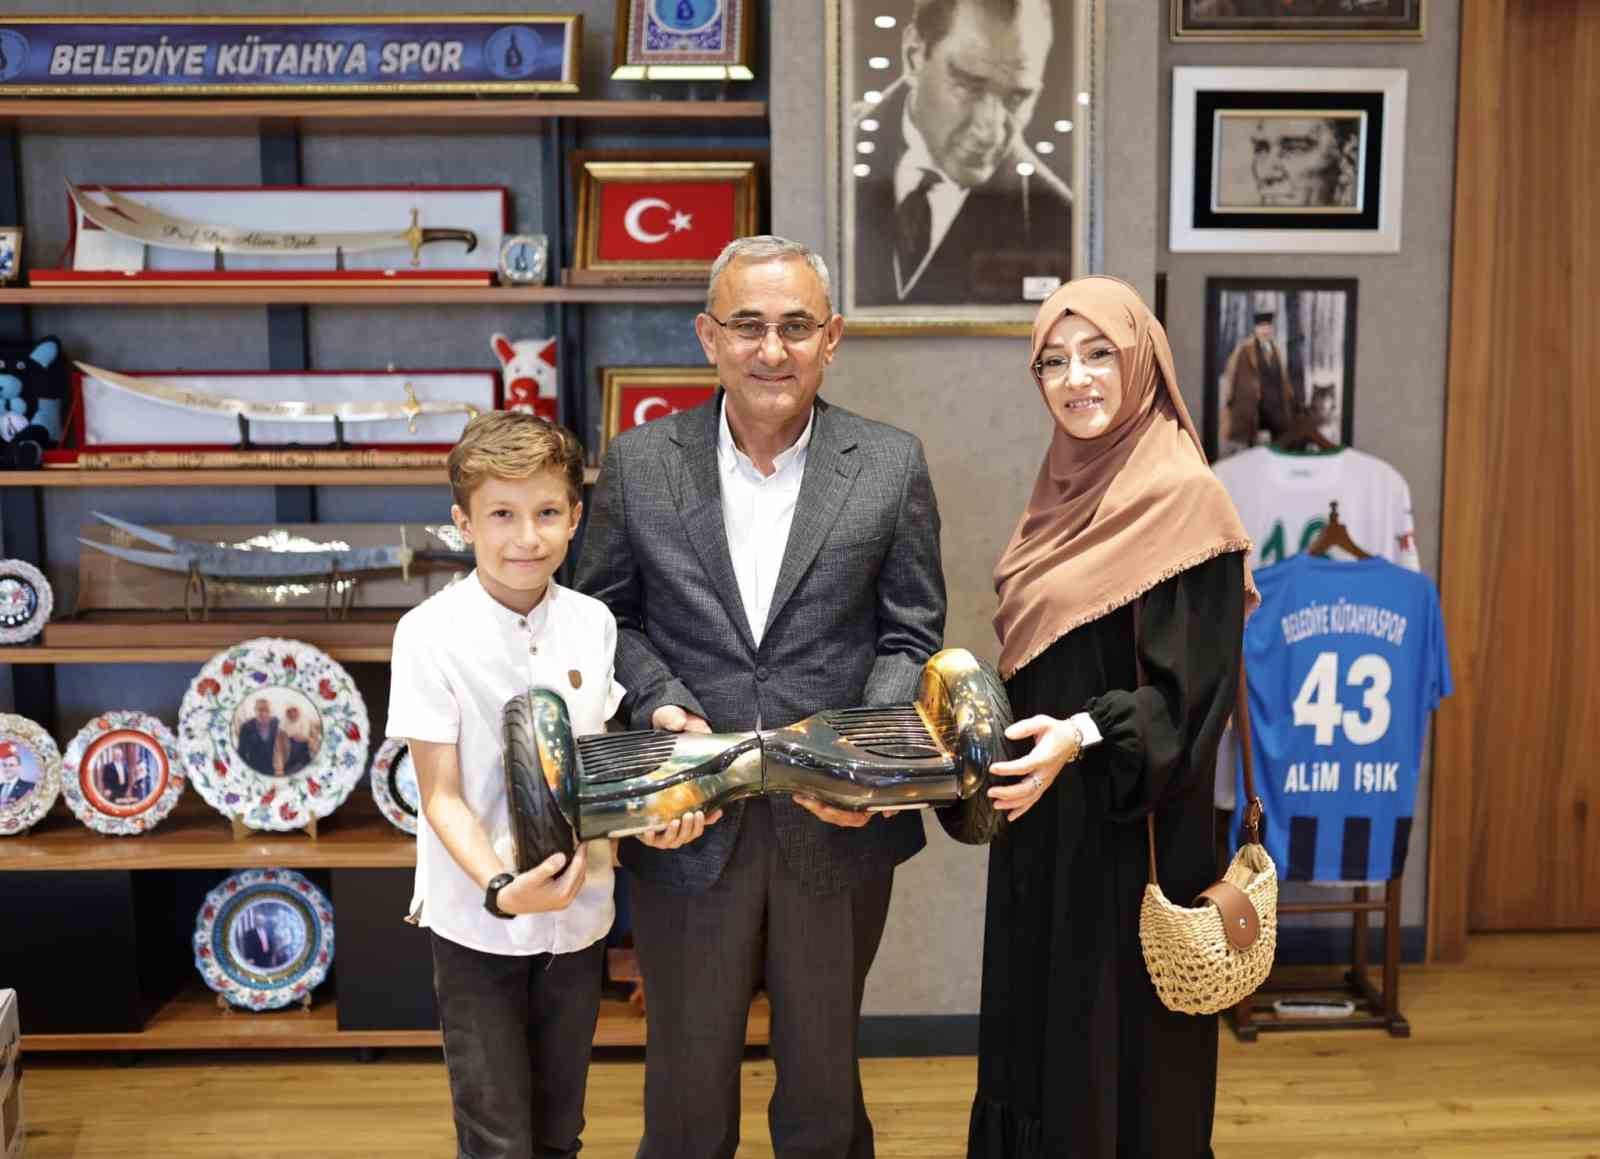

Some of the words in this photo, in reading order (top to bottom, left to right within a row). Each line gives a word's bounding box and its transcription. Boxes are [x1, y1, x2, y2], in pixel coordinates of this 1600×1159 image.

[50, 36, 206, 75] BELEDİYE
[216, 36, 367, 76] KÜTAHYA
[378, 41, 464, 74] SPOR
[1281, 600, 1329, 645] BELEDİYE
[1292, 651, 1392, 746] 43
[1353, 761, 1400, 793] IŞIK
